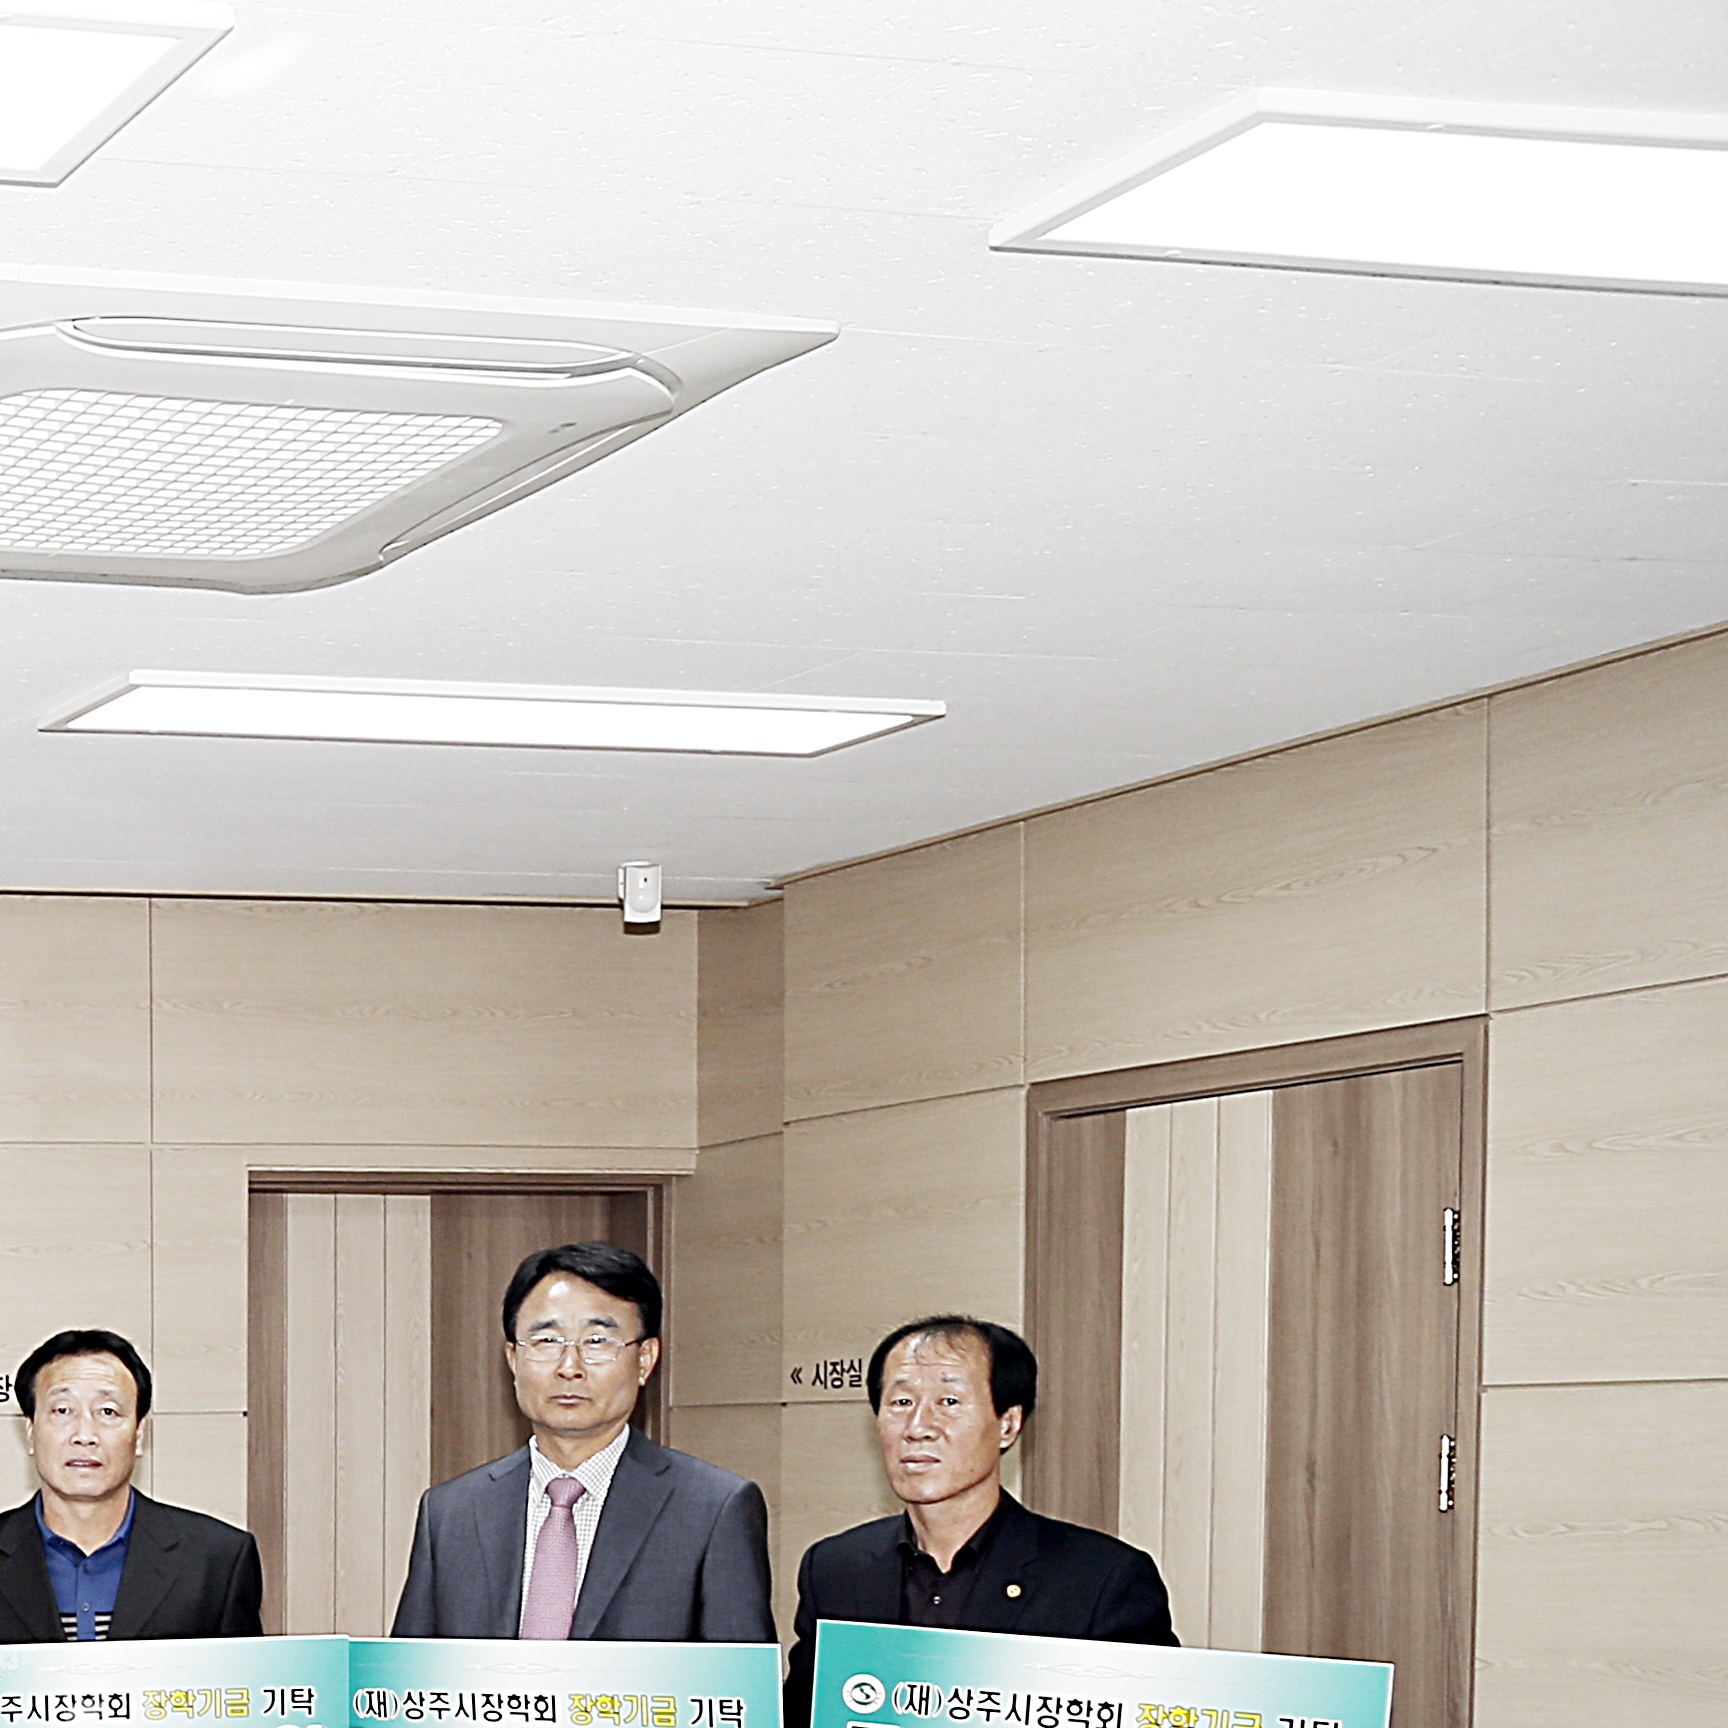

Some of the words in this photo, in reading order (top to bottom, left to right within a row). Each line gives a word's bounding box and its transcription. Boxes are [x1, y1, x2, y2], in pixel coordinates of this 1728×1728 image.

[812, 1358, 862, 1389] 시장실
[143, 1688, 251, 1720] 장학기금
[262, 1688, 316, 1716] 기탁
[354, 1690, 558, 1722] (재)상주시장학회
[568, 1693, 678, 1727] 장학기금
[689, 1697, 746, 1728] 기탁
